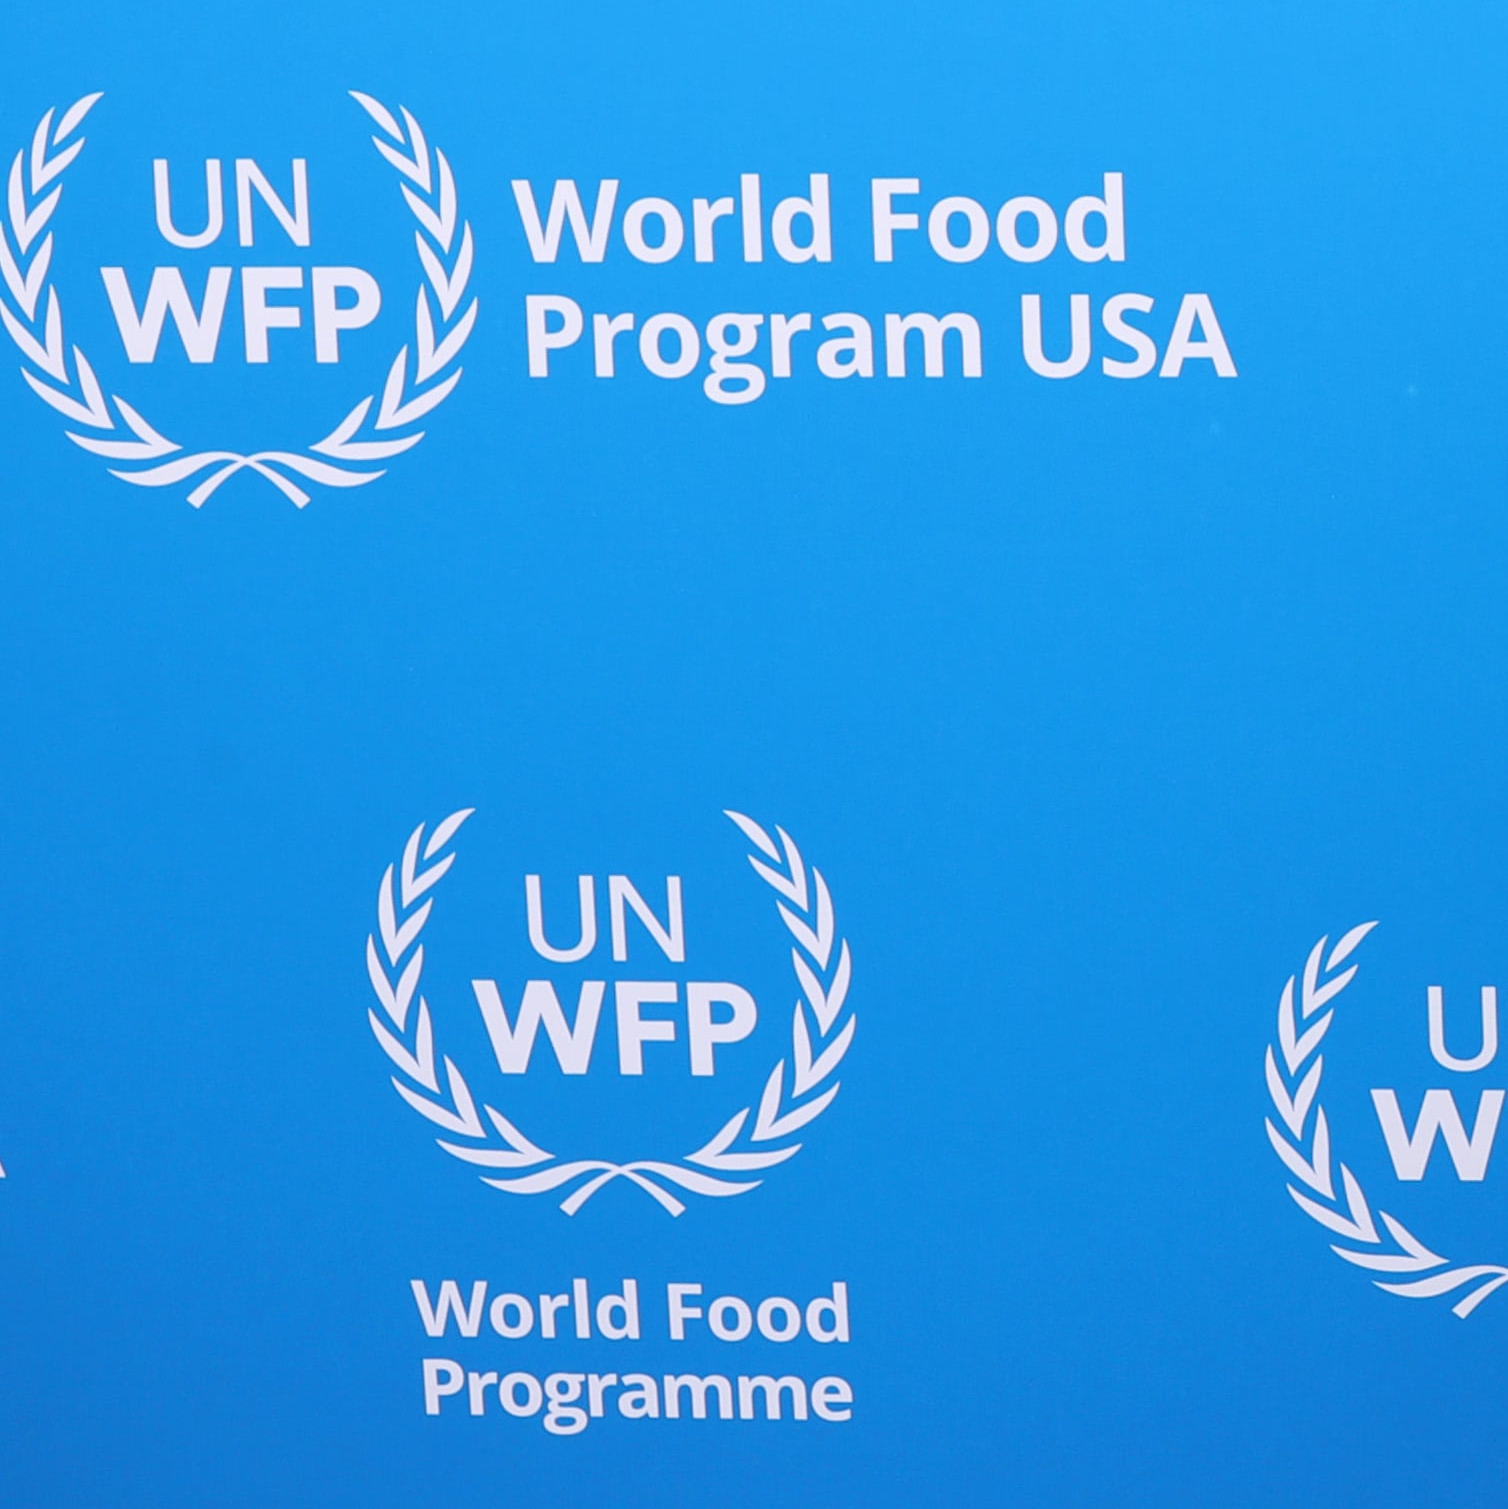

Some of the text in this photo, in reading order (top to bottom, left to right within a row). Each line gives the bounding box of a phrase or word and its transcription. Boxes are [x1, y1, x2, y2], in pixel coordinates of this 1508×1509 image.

[154, 159, 310, 248] UN
[511, 172, 1125, 263] World Food
[101, 267, 381, 363] WFP
[526, 293, 1237, 404] Program USA
[526, 875, 684, 962] UN
[472, 980, 757, 1075] WFP
[411, 1279, 849, 1342] World Food
[423, 1359, 852, 1434] Programme
